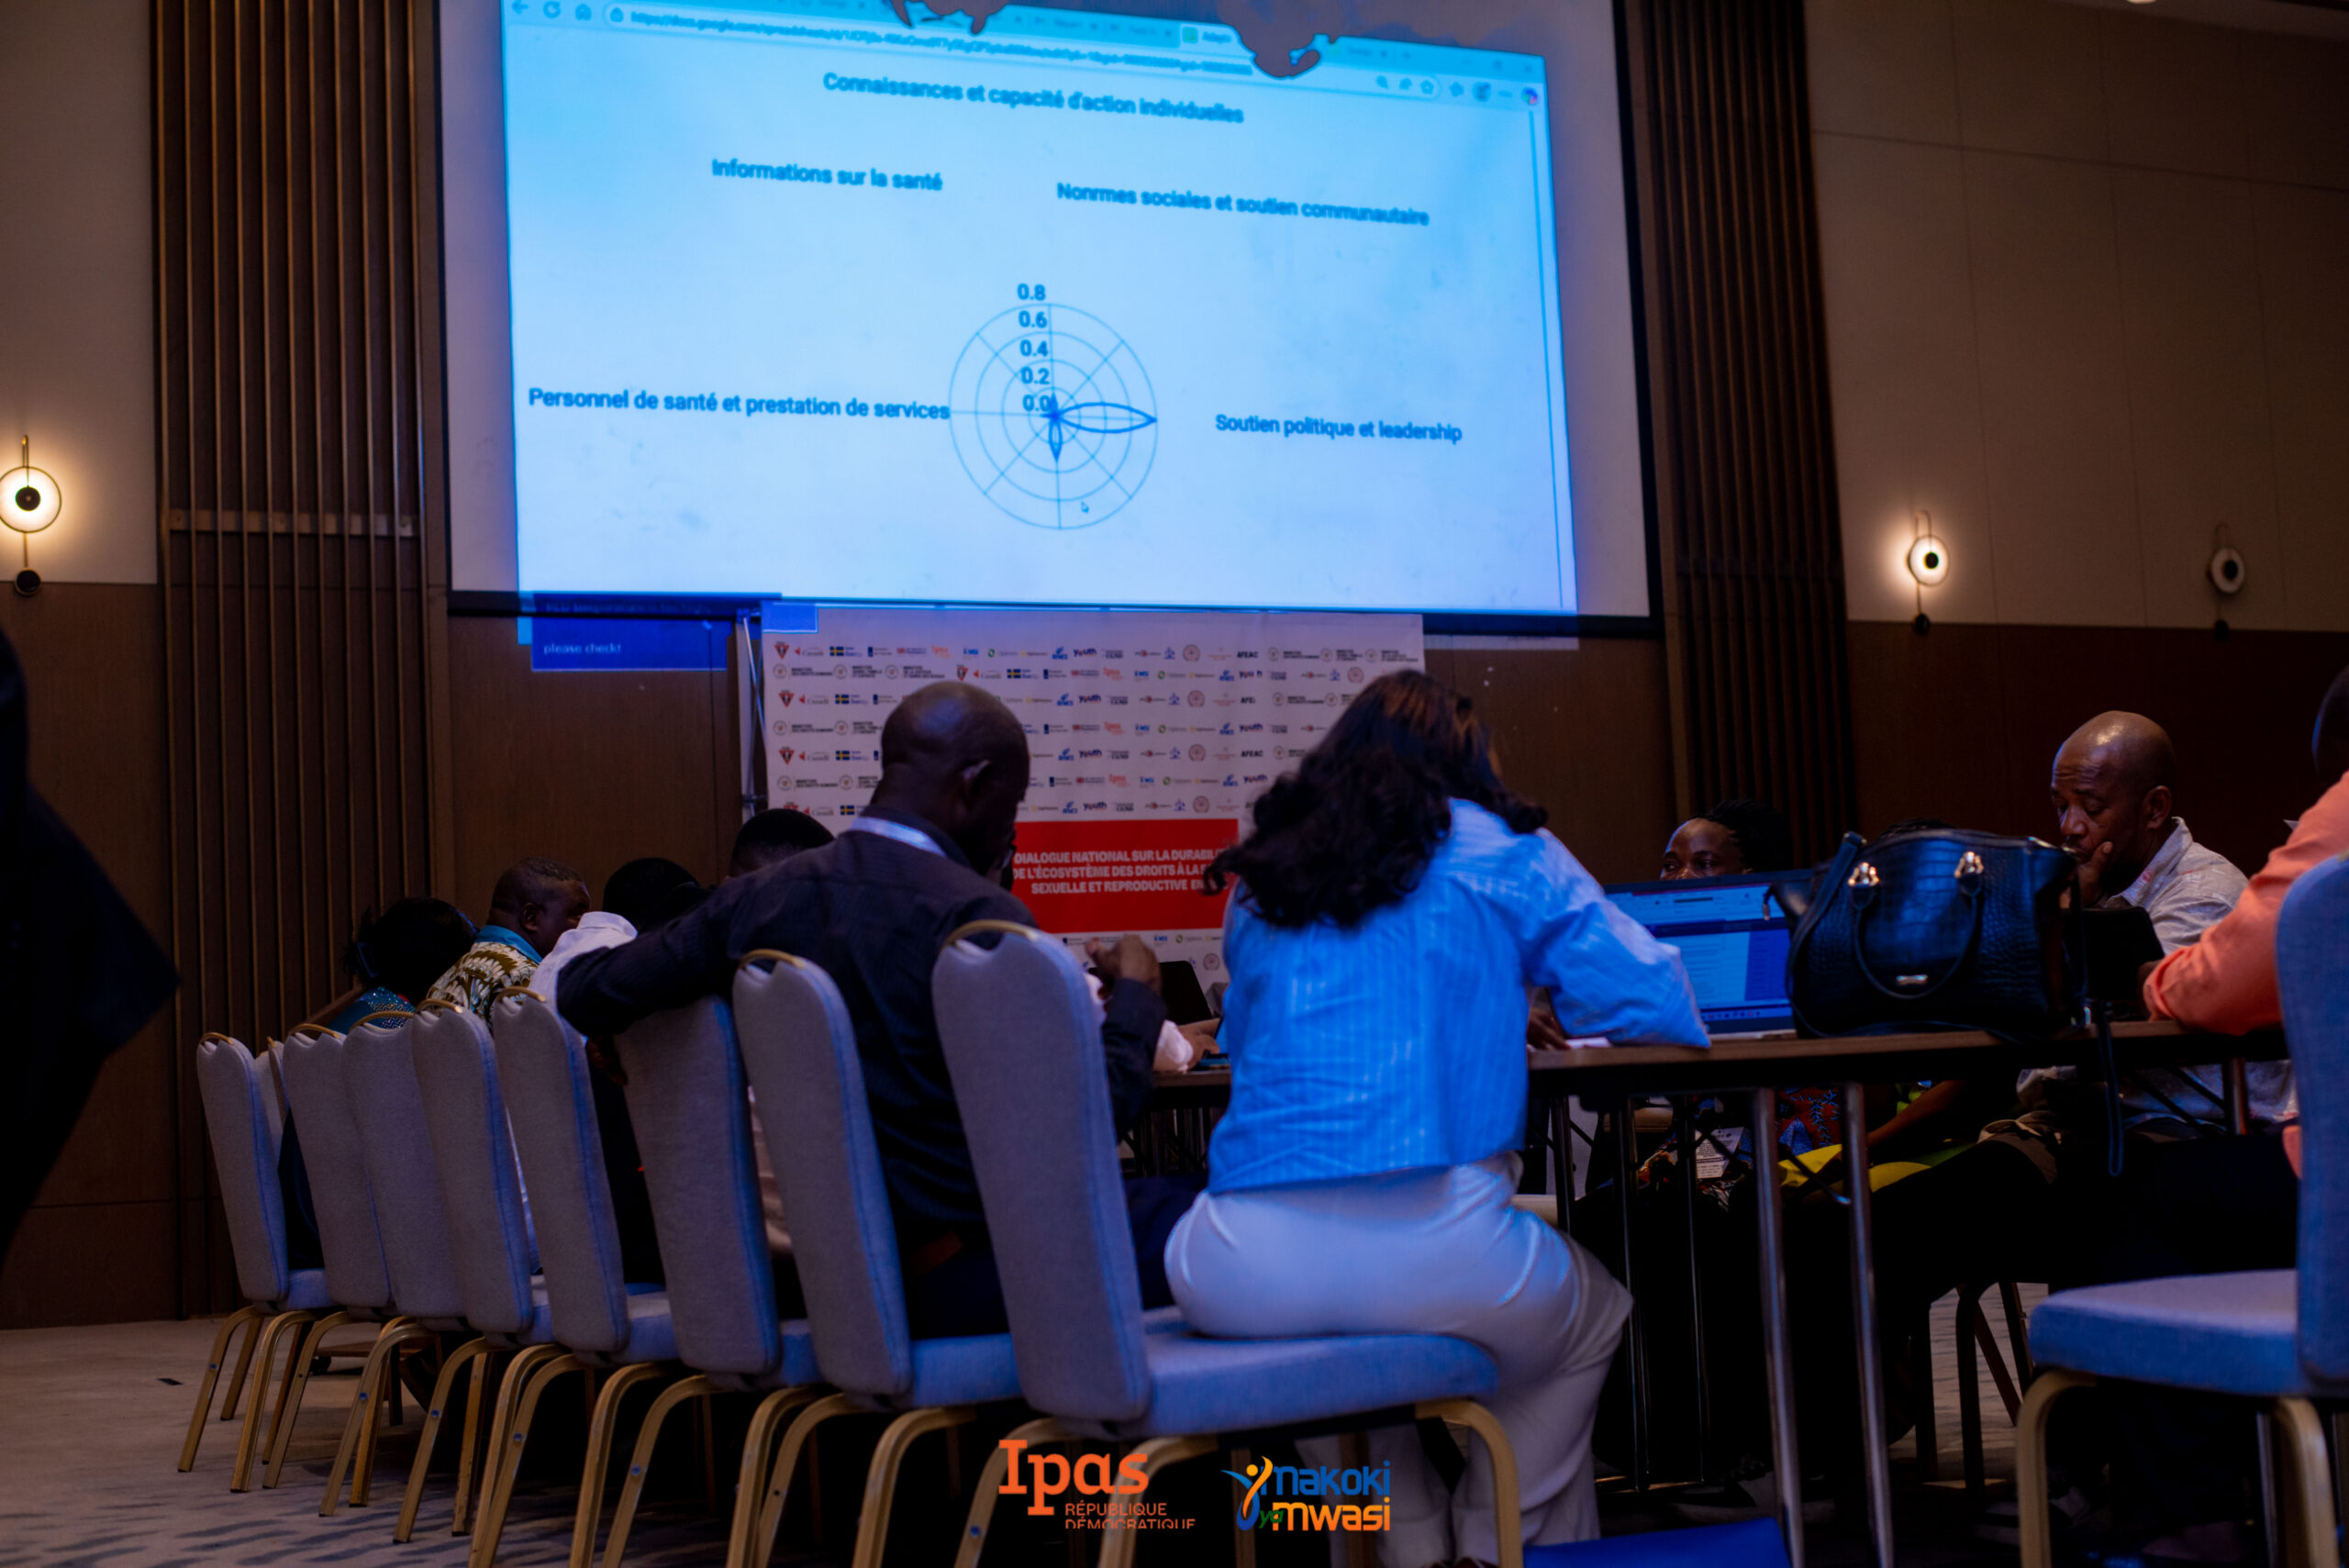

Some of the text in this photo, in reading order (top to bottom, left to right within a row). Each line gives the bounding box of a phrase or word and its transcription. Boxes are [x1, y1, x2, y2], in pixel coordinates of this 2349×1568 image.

[822, 72, 963, 100] Connaissances
[966, 84, 985, 102] et
[988, 89, 1064, 109] capacité
[1067, 91, 1136, 114] d'action
[711, 157, 943, 191] Informations sur la santé
[1141, 190, 1212, 209] sociales
[1215, 194, 1231, 211] et
[1235, 197, 1298, 216] soutien
[1301, 202, 1430, 226] communautaire
[1018, 284, 1047, 302] 0.8
[1019, 310, 1048, 329] 0.6
[1019, 339, 1050, 357] 0.4
[1020, 367, 1051, 385] 0.2
[529, 387, 951, 419] Personnel de santé et prestation de services
[1022, 395, 1052, 413] 0.0
[1215, 413, 1463, 445] Soutien politique et leadership
[543, 642, 582, 656] please
[1014, 851, 1071, 864] DIALOGUE
[1071, 850, 1130, 863] NATIONAL
[1131, 849, 1154, 862] SUR
[1155, 849, 1171, 861] LA
[1027, 863, 1110, 879] L'ÉCOSYSTÈME
[1111, 864, 1134, 877] DES
[1135, 863, 1175, 876] DROITS
[1176, 860, 1185, 875] À
[1186, 862, 1199, 875] LA
[1030, 882, 1087, 895] SEXUELLE
[1087, 881, 1103, 893] ET
[1103, 879, 1188, 893] REPRODUCTIVE
